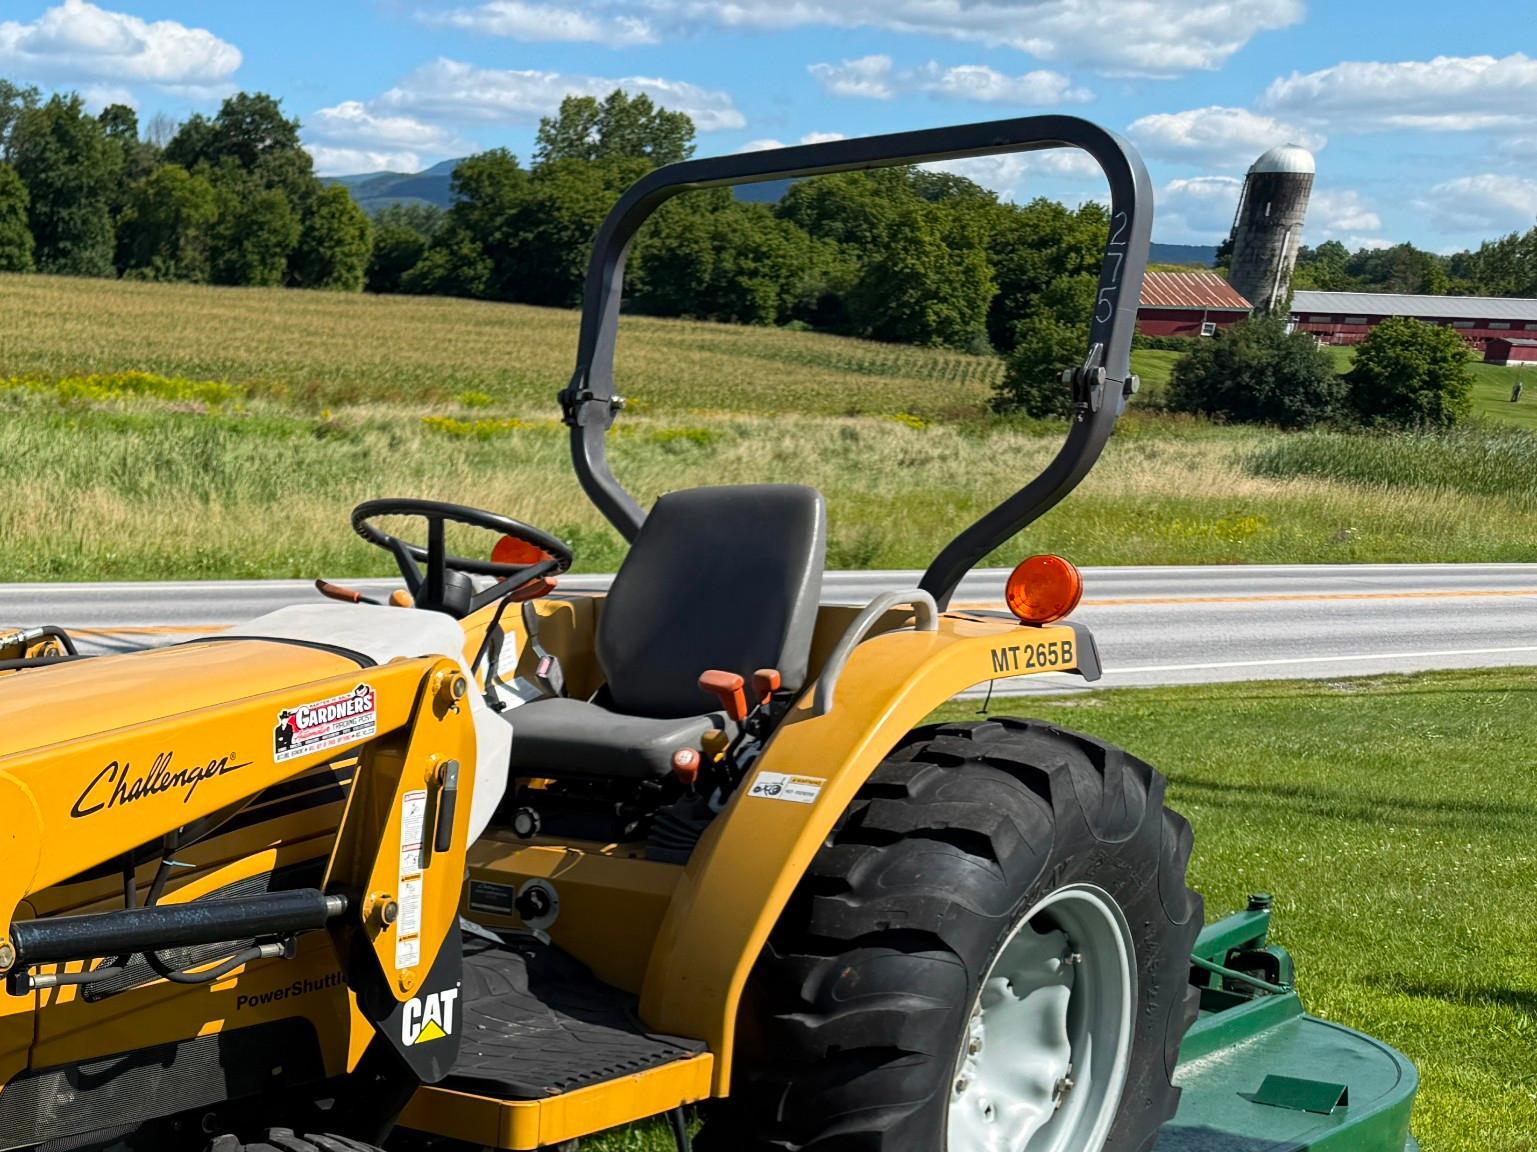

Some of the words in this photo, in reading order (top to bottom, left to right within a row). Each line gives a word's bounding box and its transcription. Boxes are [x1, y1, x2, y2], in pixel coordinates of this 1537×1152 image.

[295, 694, 373, 730] GARDNERS
[69, 751, 254, 819] Challenger
[401, 987, 459, 1047] CAT
